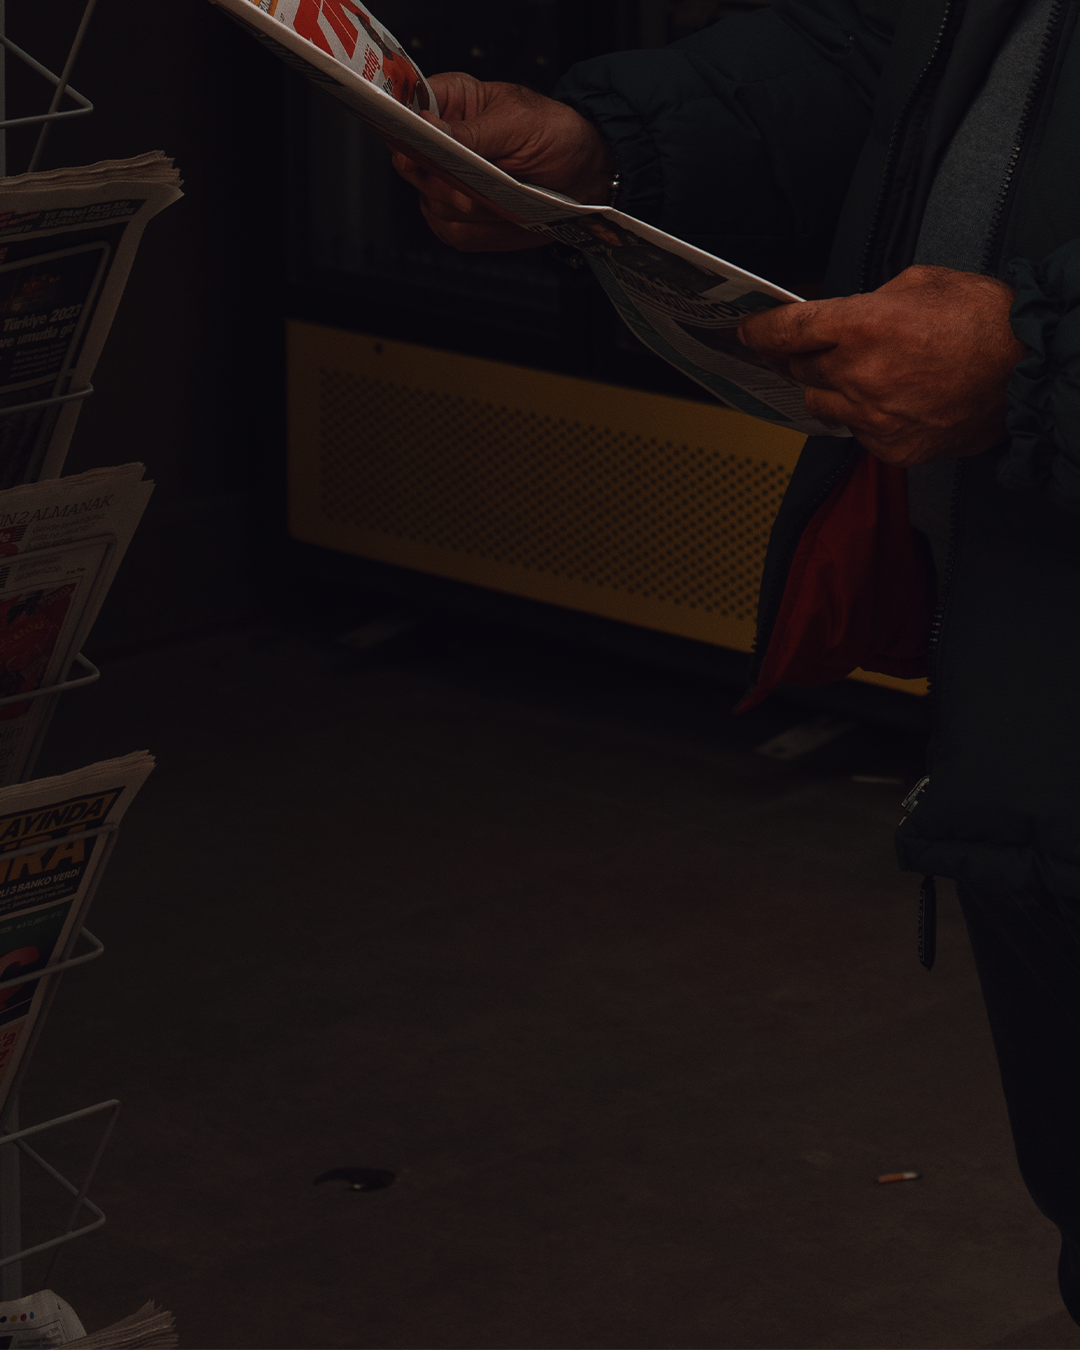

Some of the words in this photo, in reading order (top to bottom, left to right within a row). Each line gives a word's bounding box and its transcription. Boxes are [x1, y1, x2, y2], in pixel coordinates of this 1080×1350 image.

[3, 312, 48, 332] Türkiye
[29, 493, 115, 523] ALMANAK
[0, 797, 105, 841] AYINDA
[17, 875, 53, 893] BANKO
